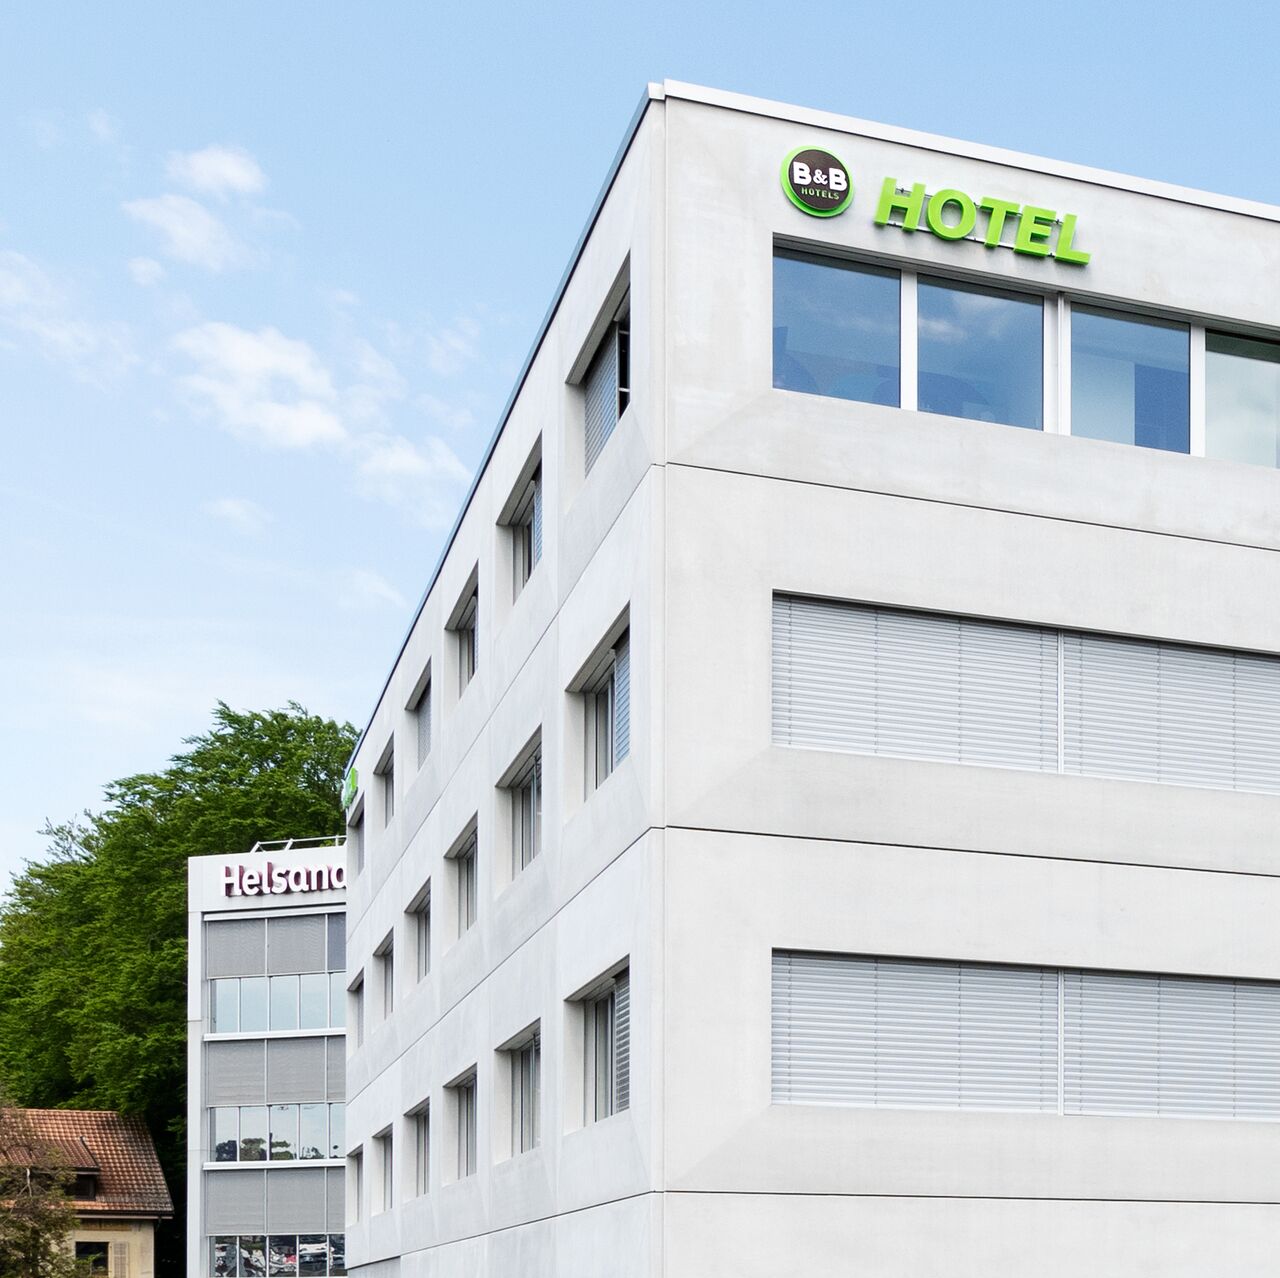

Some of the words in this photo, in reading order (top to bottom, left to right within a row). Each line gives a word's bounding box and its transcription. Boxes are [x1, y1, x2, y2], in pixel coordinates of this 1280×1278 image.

[793, 161, 848, 192] B&B
[801, 187, 840, 200] HOTELS
[873, 176, 1092, 266] HOTEL
